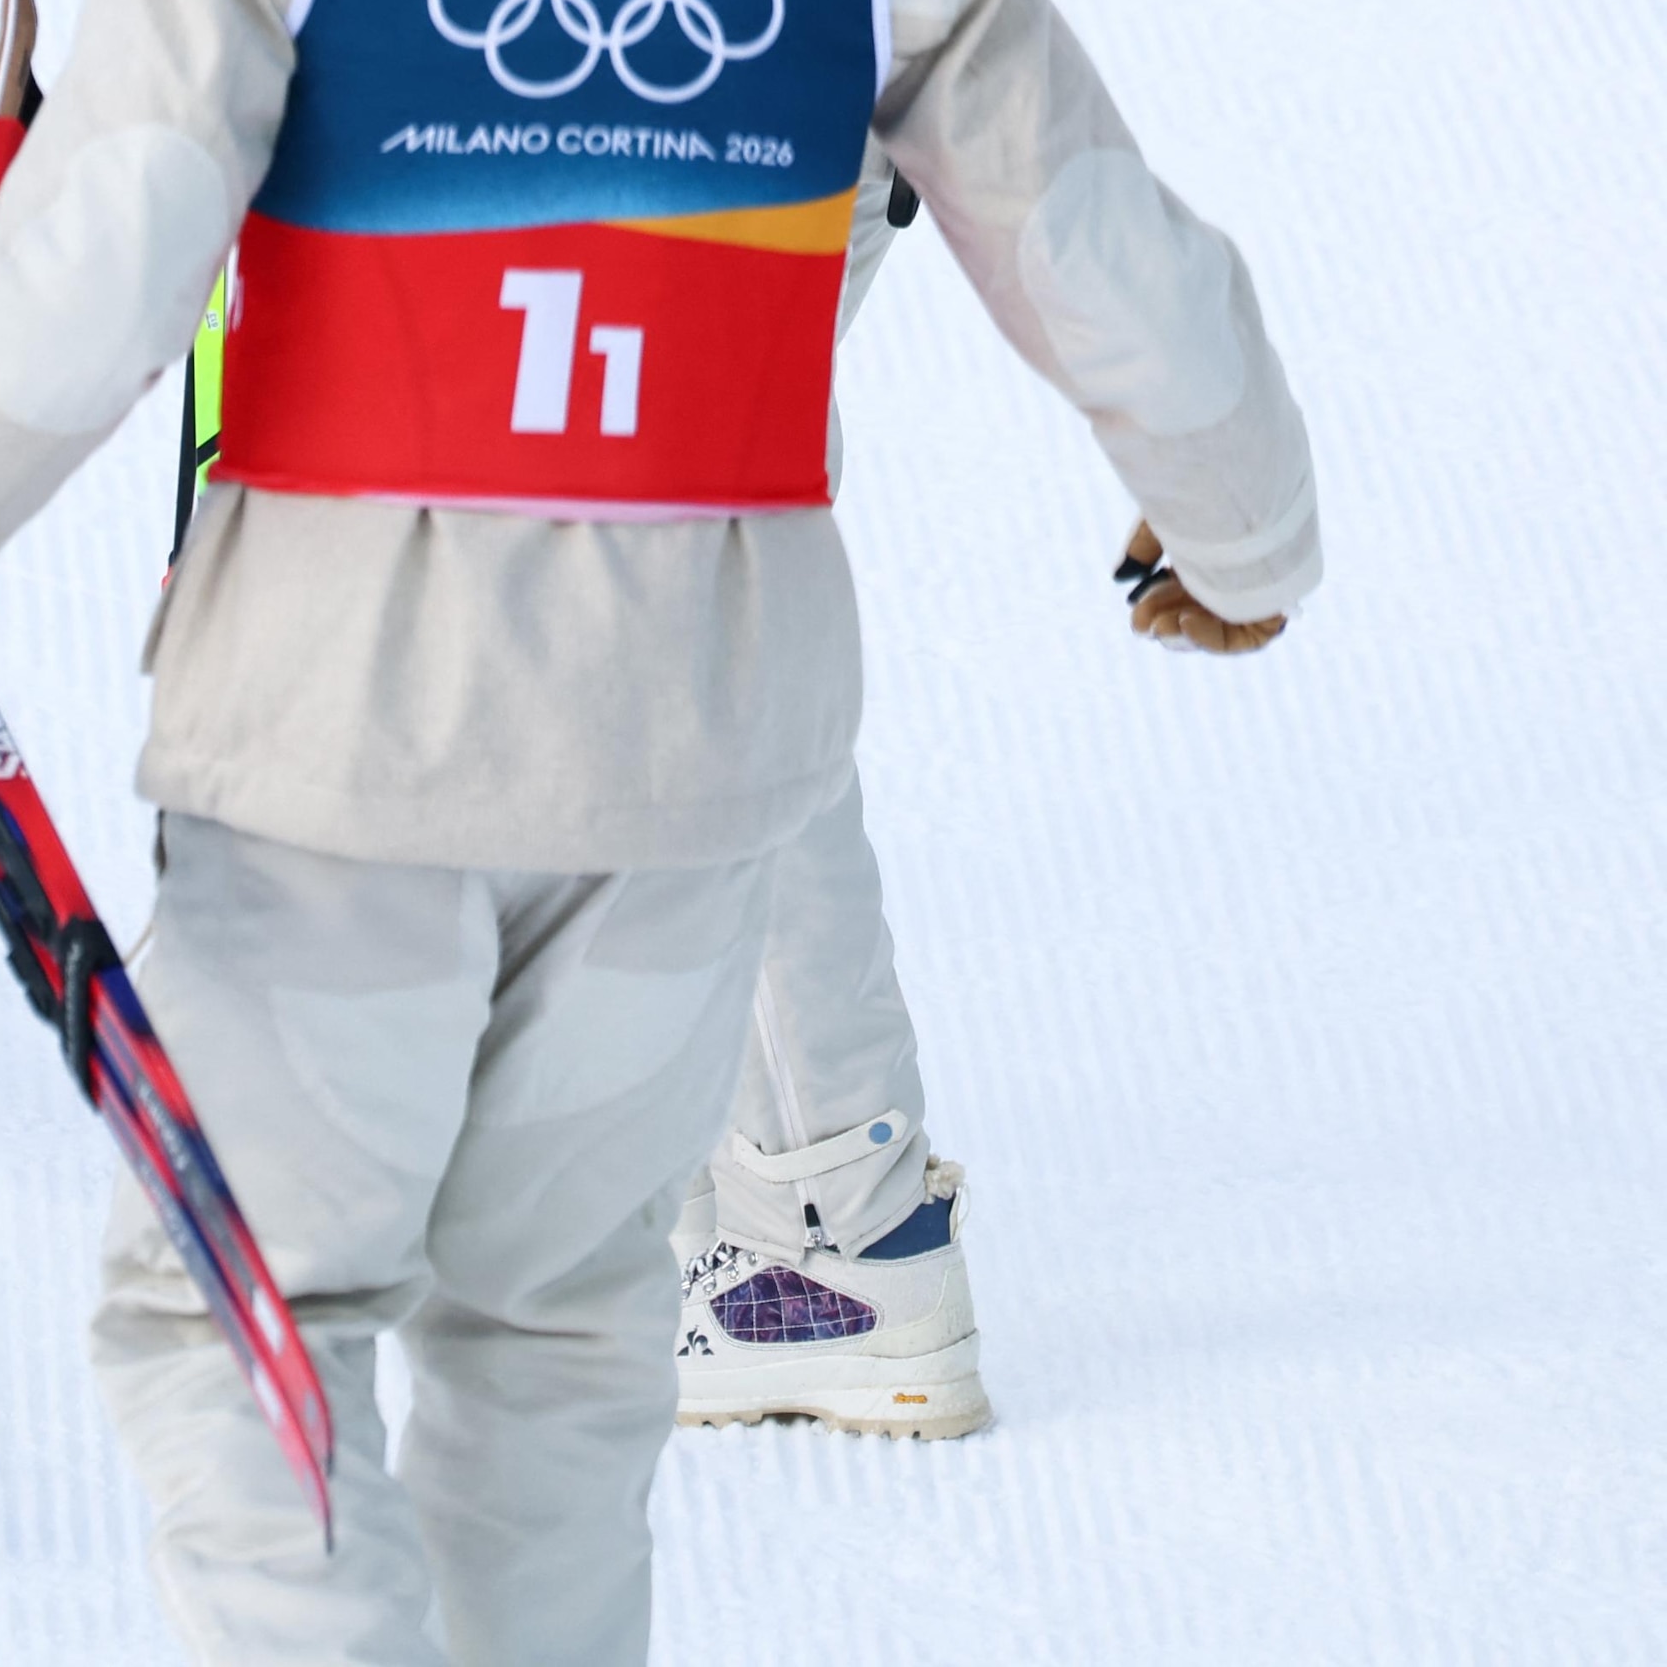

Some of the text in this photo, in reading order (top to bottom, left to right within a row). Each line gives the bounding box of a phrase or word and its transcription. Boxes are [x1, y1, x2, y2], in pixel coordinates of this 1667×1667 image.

[380, 124, 794, 167] MILANO CORTINA 2026
